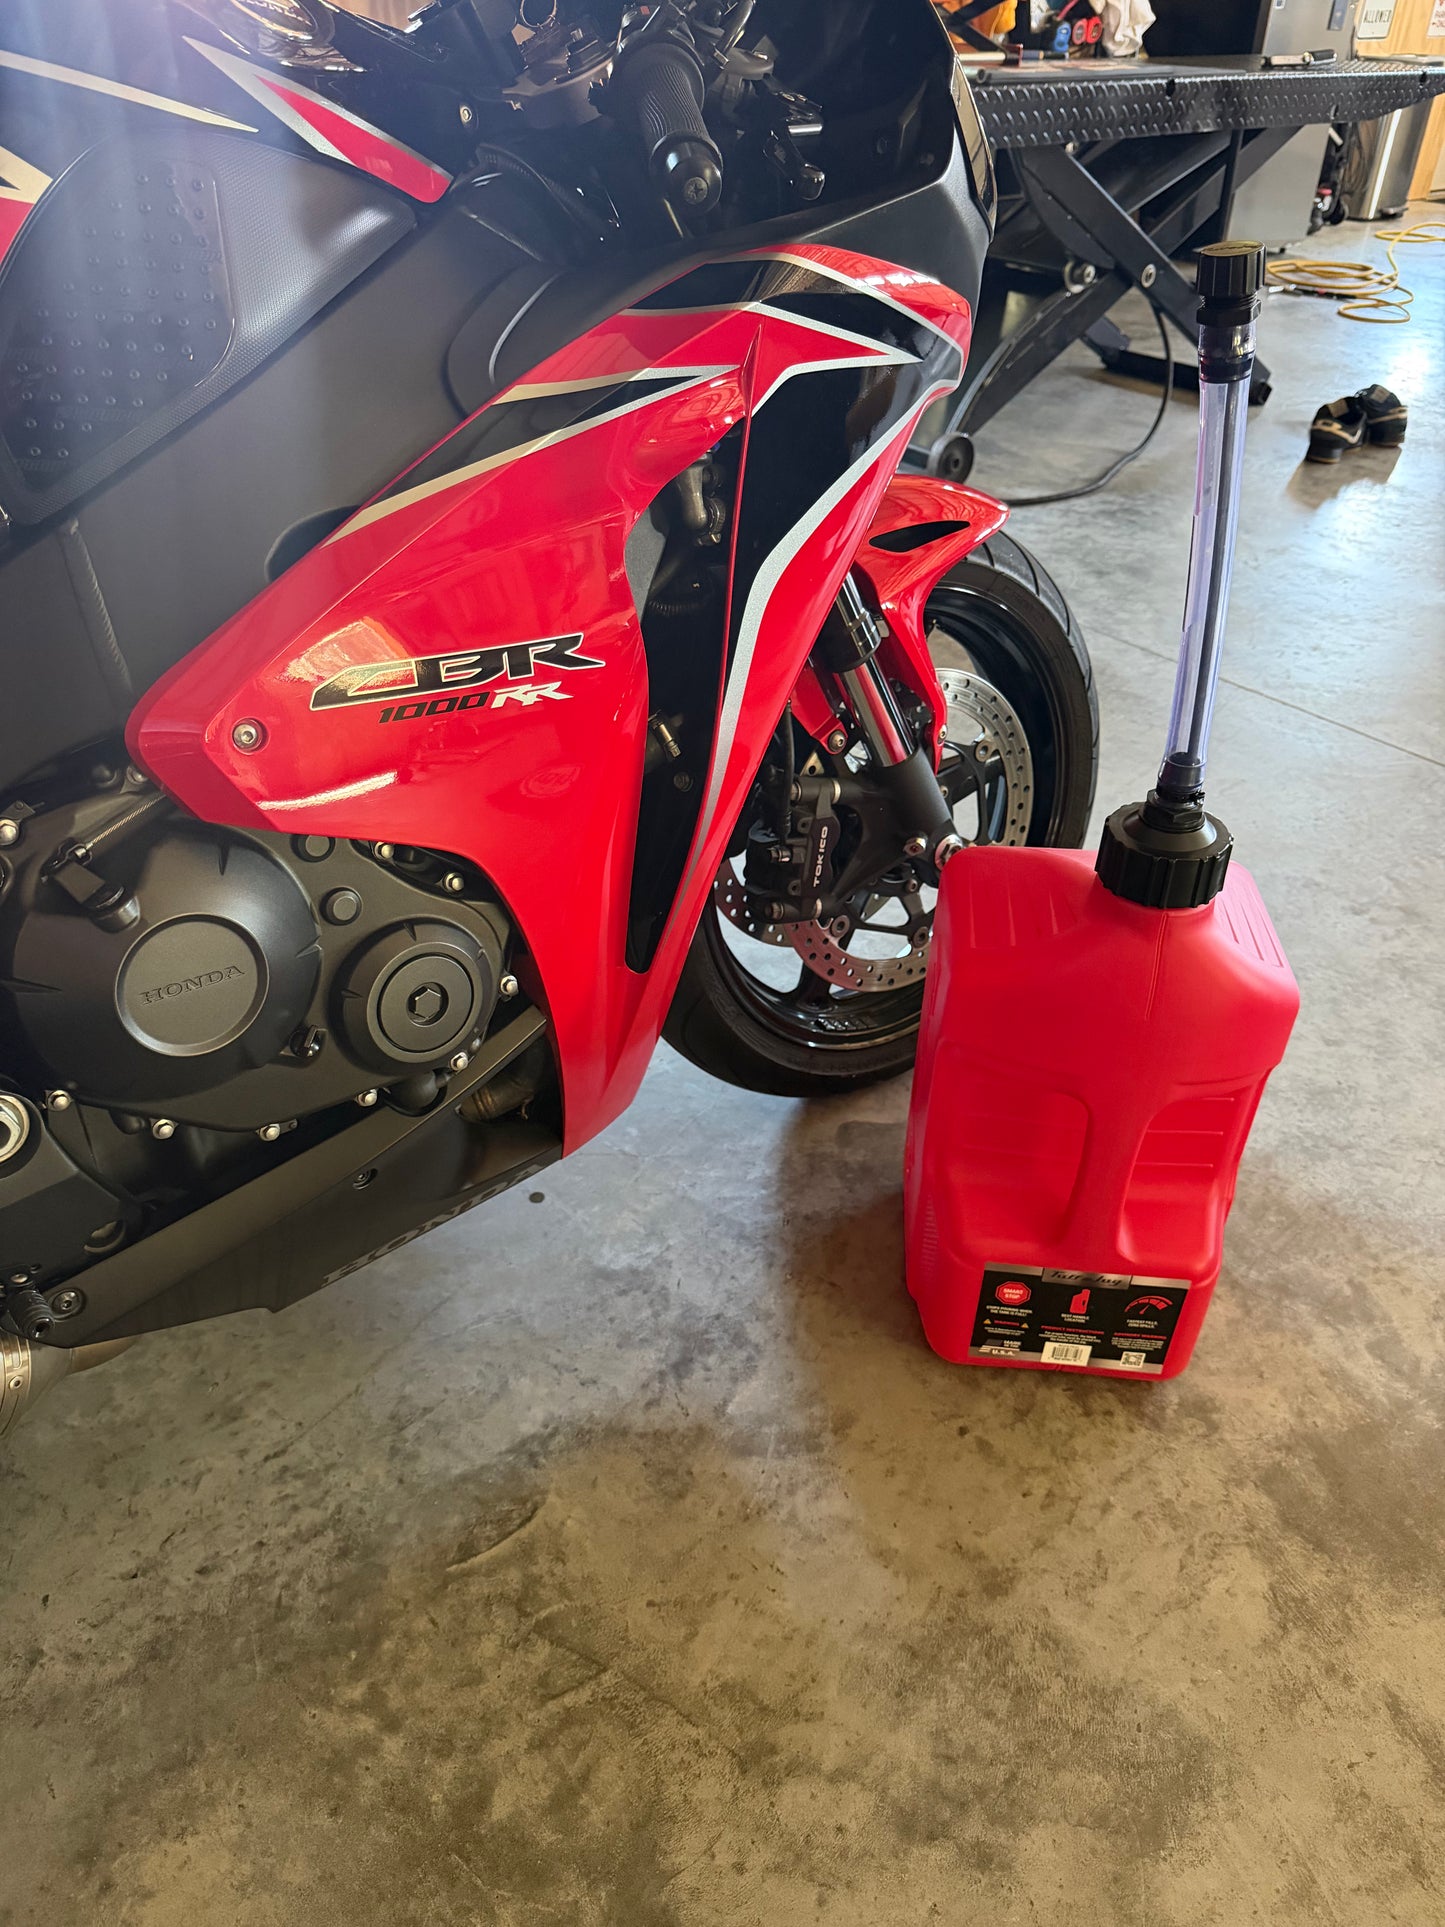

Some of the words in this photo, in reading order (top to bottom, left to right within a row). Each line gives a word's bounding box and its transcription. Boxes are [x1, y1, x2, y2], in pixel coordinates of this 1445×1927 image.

[1363, 9, 1392, 23] ALLOWED
[310, 632, 606, 711] CBR
[813, 826, 828, 887] TOKICO
[139, 965, 246, 1005] HONDA
